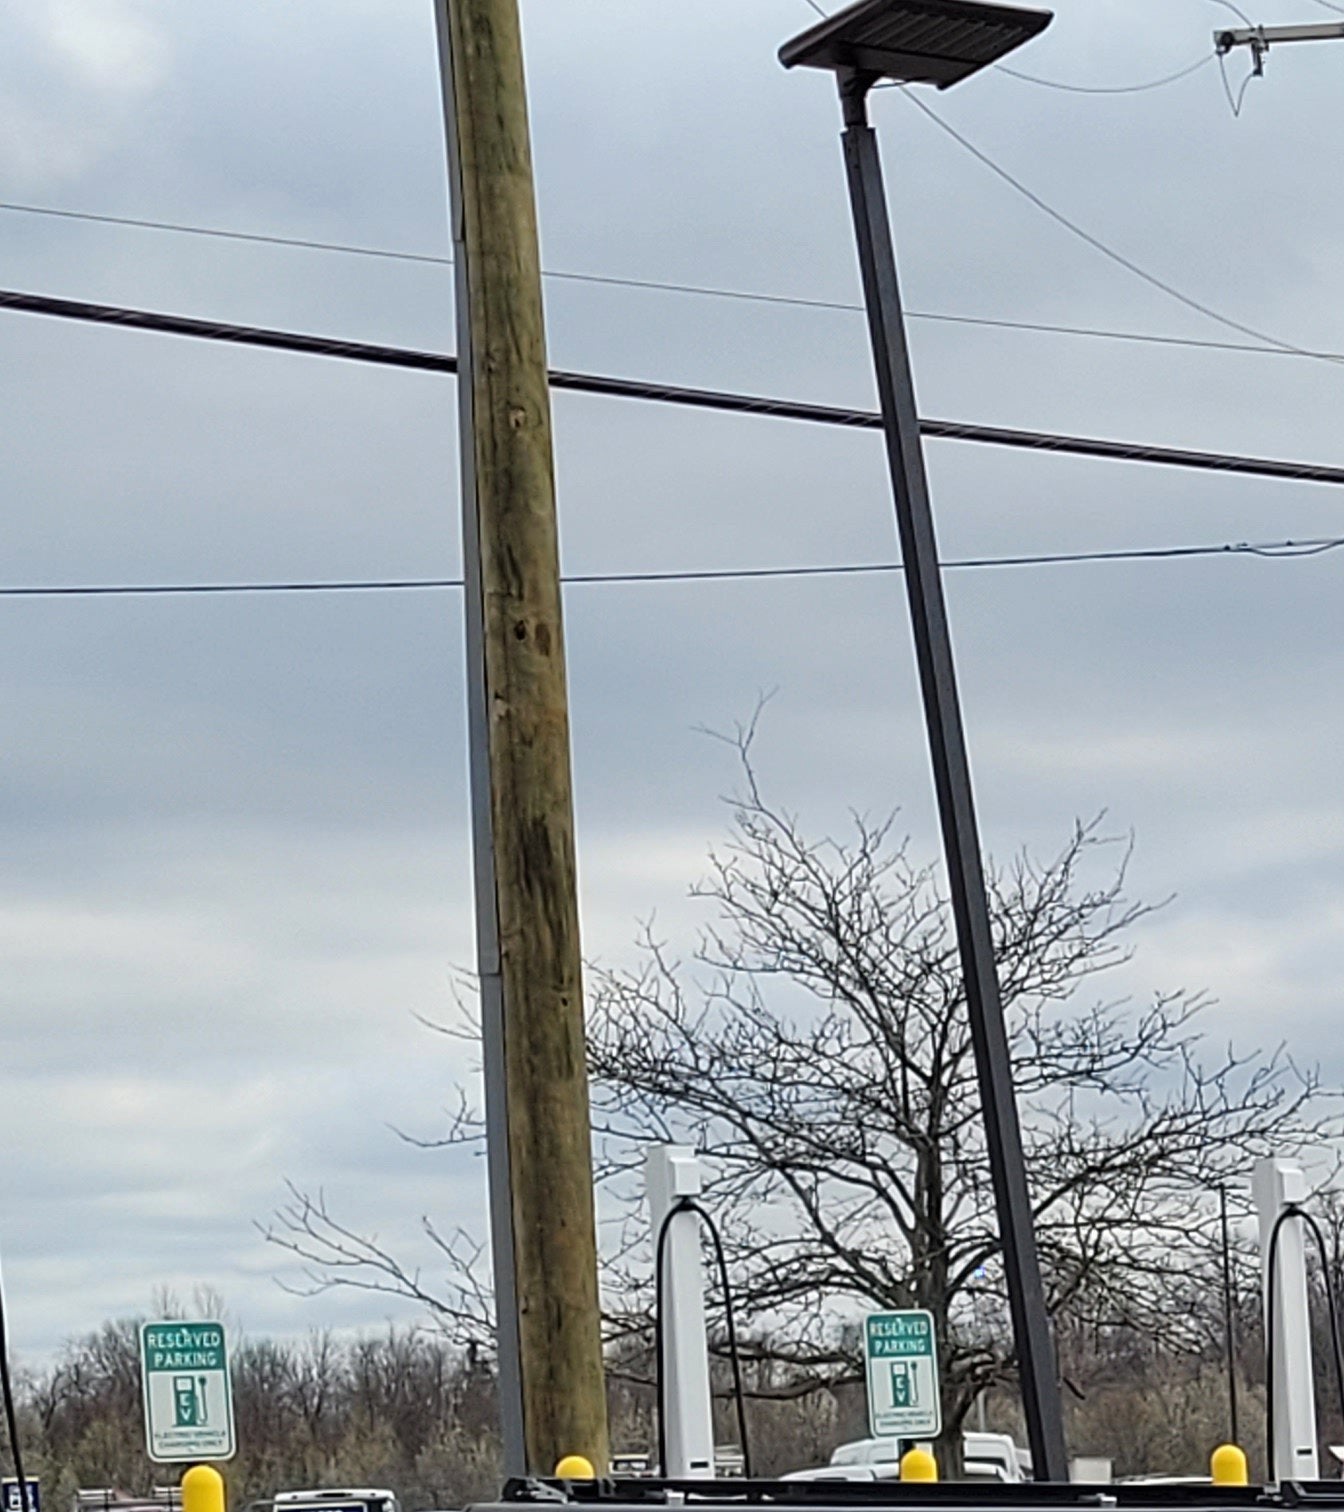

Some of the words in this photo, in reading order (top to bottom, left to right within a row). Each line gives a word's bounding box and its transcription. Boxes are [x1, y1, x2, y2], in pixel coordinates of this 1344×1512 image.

[869, 1320, 928, 1336] RESERVED
[147, 1331, 220, 1348] RESERVED
[874, 1339, 926, 1354] PARKING
[154, 1351, 217, 1367] PARKING
